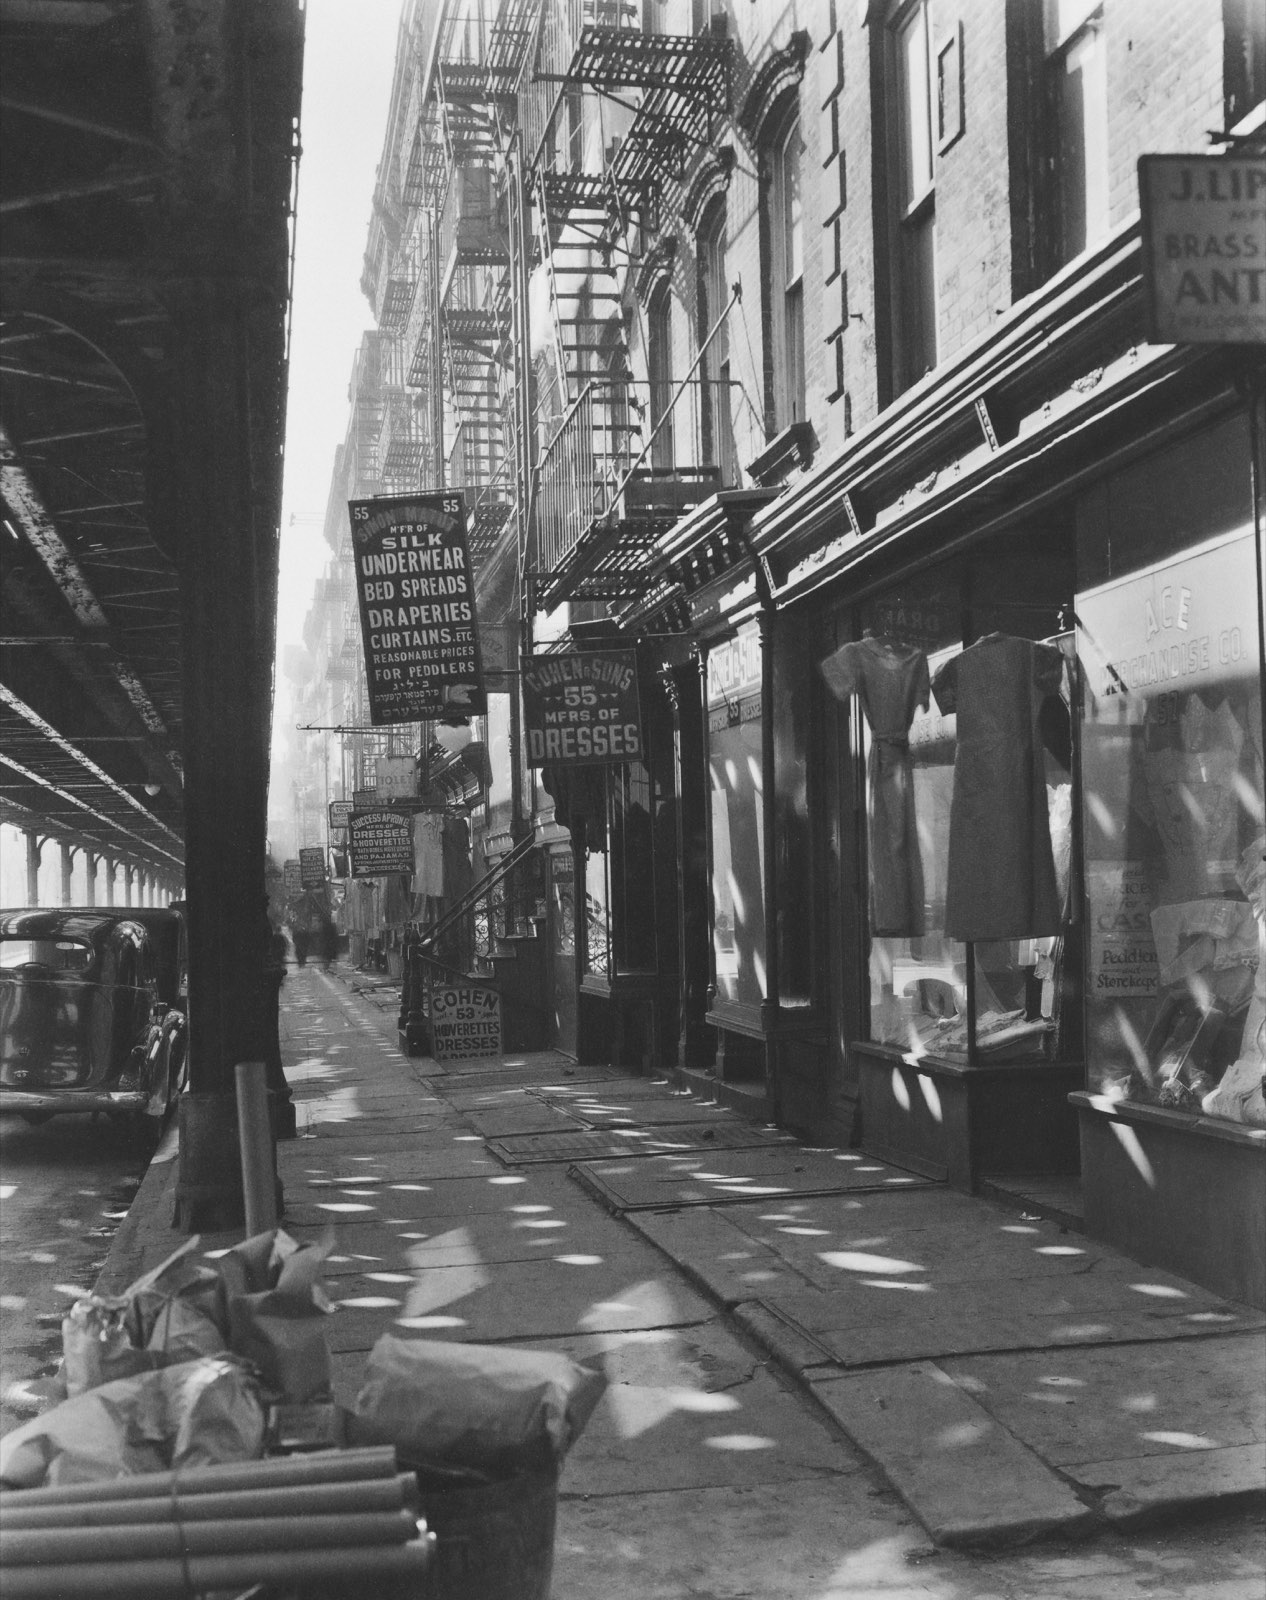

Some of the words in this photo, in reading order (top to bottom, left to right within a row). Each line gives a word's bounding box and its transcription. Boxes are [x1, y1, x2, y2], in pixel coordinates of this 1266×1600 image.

[1165, 233, 1258, 258] BRASS
[354, 507, 369, 520] 55
[443, 500, 459, 513] 55
[416, 524, 429, 532] OF
[382, 532, 443, 550] SILK
[361, 547, 465, 576] UNDERWEAR
[364, 581, 394, 602] BED
[401, 575, 467, 599] SPREADS
[368, 602, 472, 629] DRAPERIES
[1145, 585, 1192, 643] ACE
[373, 649, 439, 664] REASONABLE
[441, 646, 475, 658] PRICES
[375, 667, 401, 681] FOR
[409, 661, 475, 678] PEDDLERS
[525, 658, 583, 692] COHEN
[592, 659, 634, 691] SONS
[564, 685, 597, 706] 55
[598, 708, 620, 720] OF
[529, 724, 640, 760] DRESSES
[351, 813, 381, 830] SUCCESS
[382, 813, 405, 825] APRON
[353, 828, 409, 839] DRESSES
[358, 837, 411, 847] HOOVERETTES
[433, 990, 499, 1012] COHEN
[456, 1007, 475, 1020] 53
[435, 1036, 499, 1052] DRESSES
